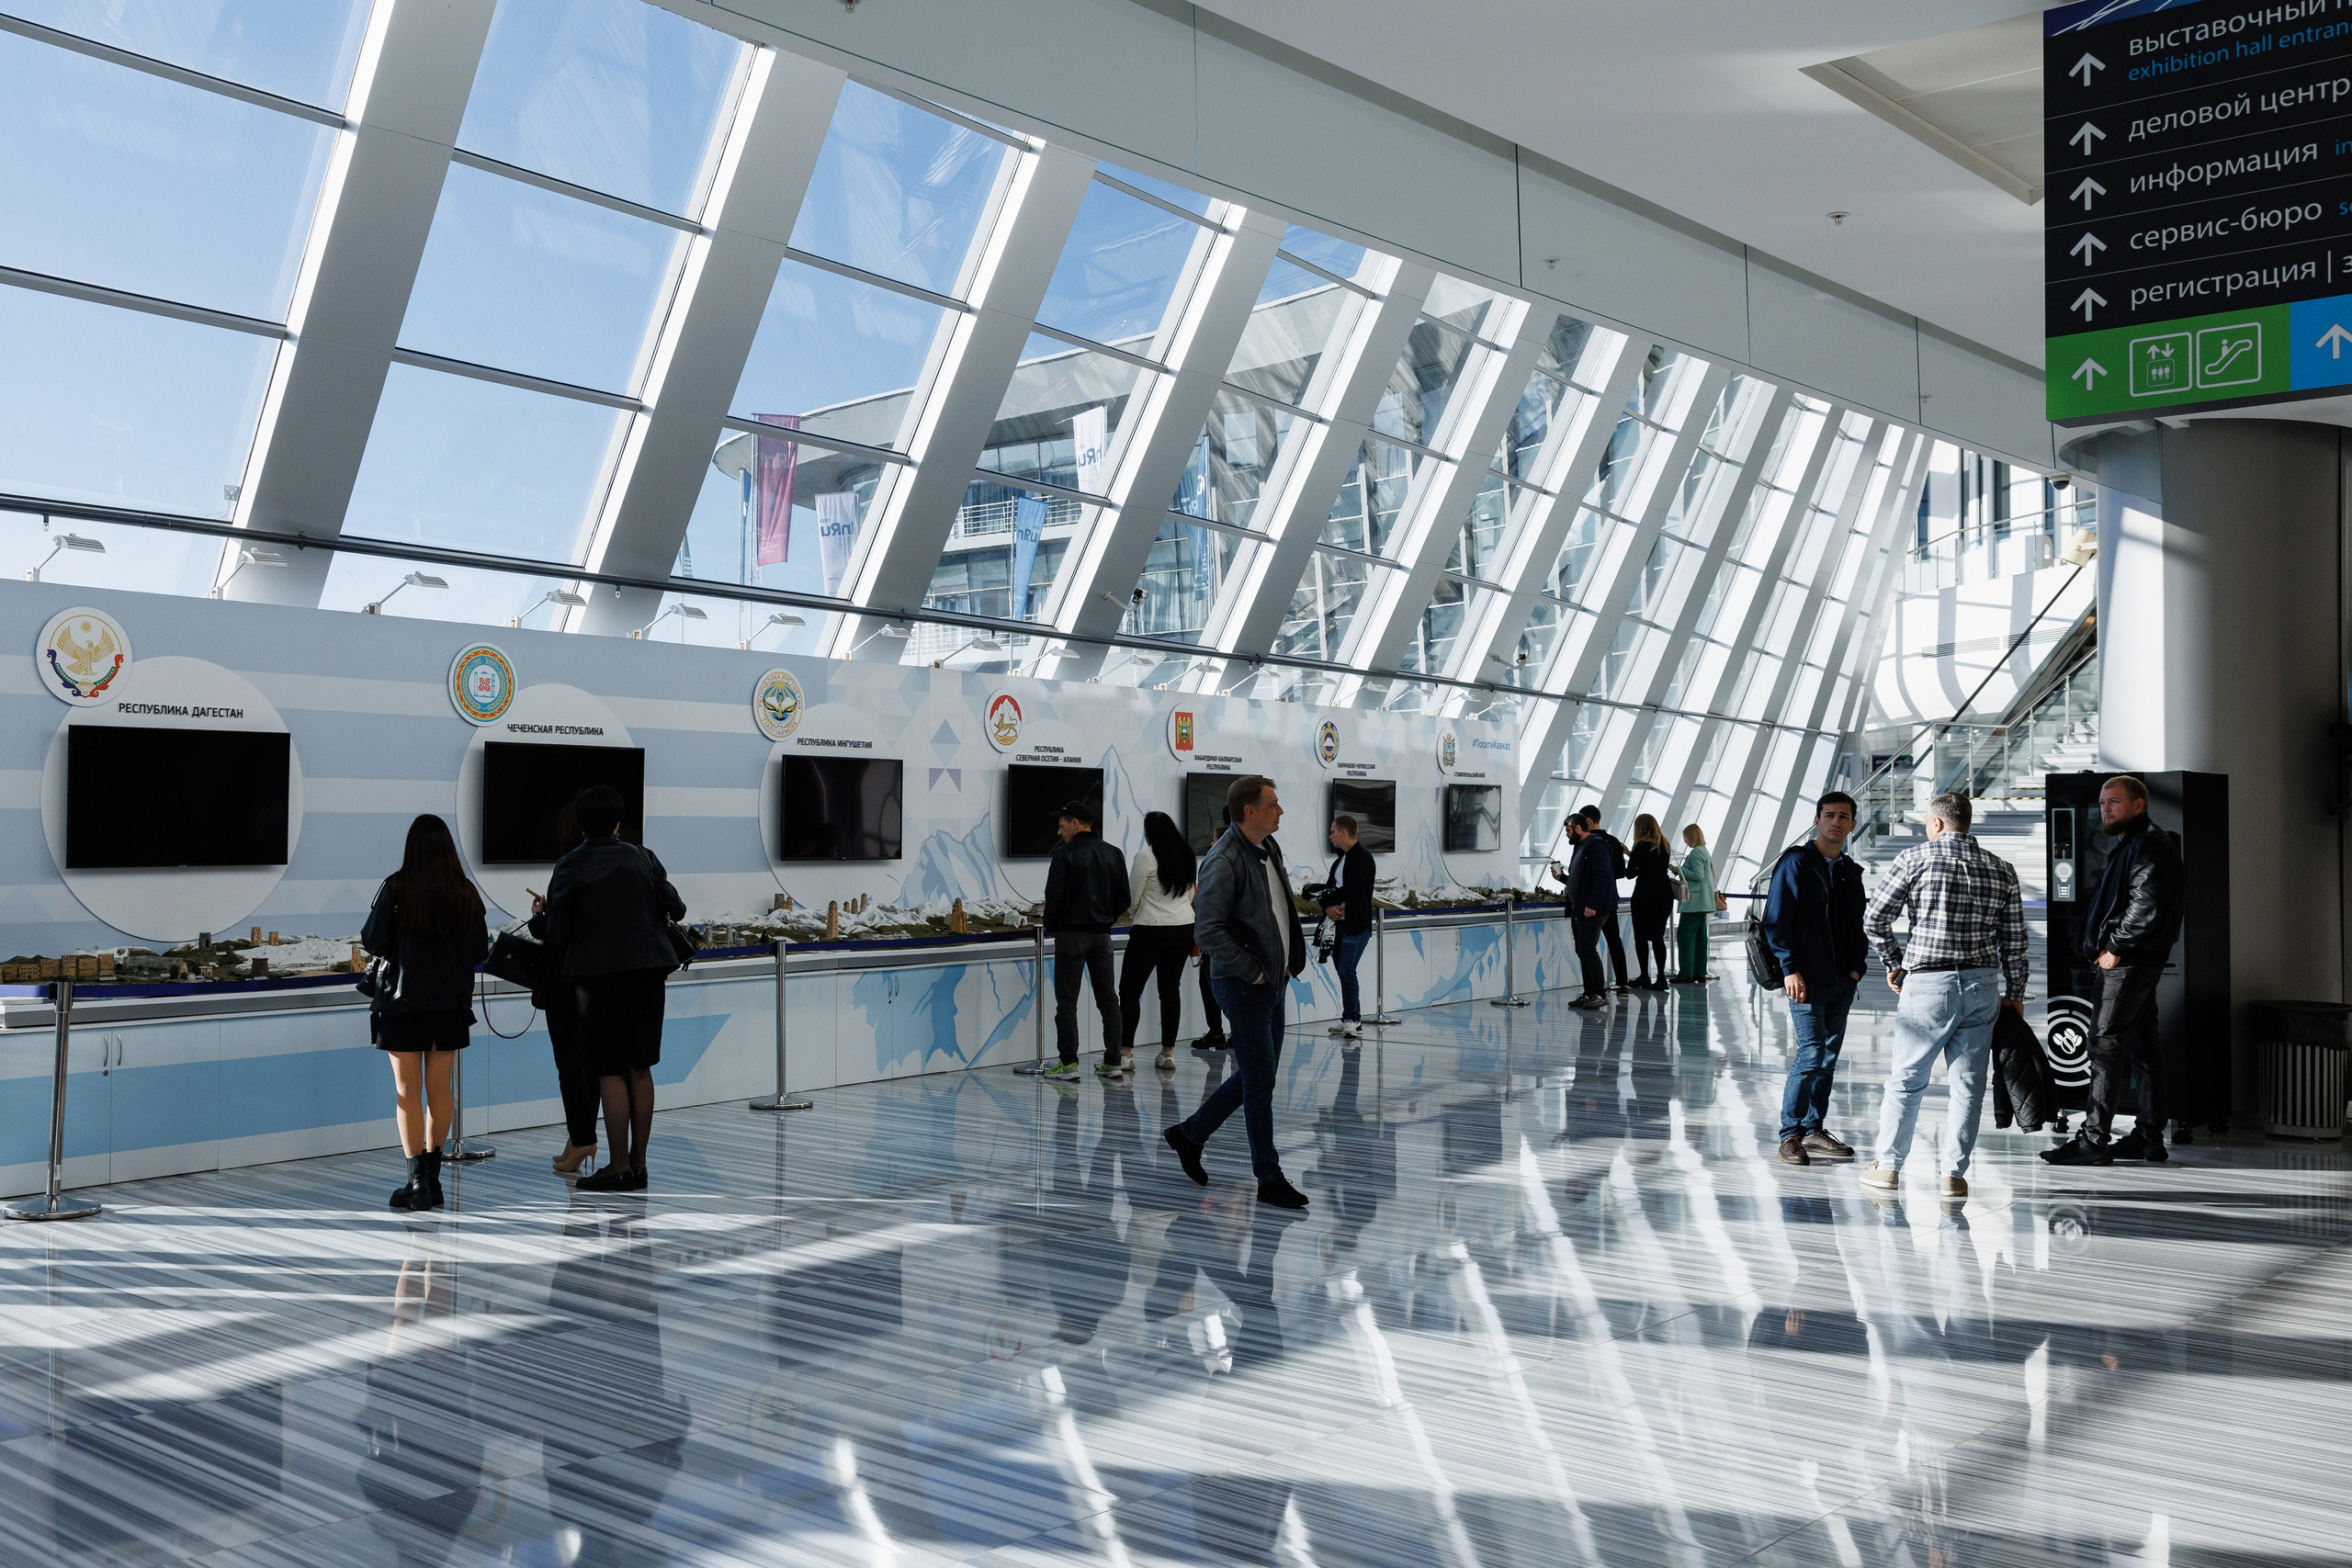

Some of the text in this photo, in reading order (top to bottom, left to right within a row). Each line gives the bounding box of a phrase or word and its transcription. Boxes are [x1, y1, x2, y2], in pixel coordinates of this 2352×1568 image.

[2129, 0, 2326, 56] выставочный
[2128, 20, 2352, 82] exhibition hall entran
[2128, 77, 2351, 142] деловой центр
[2130, 142, 2318, 194] информация
[2130, 201, 2323, 251] сервис-бюро
[2131, 260, 2316, 310] регистрация
[119, 702, 243, 718] РЕСПУБЛИКА ДАГЕСТАН
[507, 723, 605, 736] ЧЕЧЕНСКАЯ РЕСПУБЛИКА
[797, 738, 873, 749] РЕСПУБЛИКА ИНГУШЕТИЯ
[1472, 739, 1511, 750] #ПосетиКавказ
[1016, 754, 1041, 762] СЕВЕРНАЯ
[1063, 755, 1081, 763] АЛАНИЯ
[1035, 745, 1064, 753] РЕСПУБЛИКА
